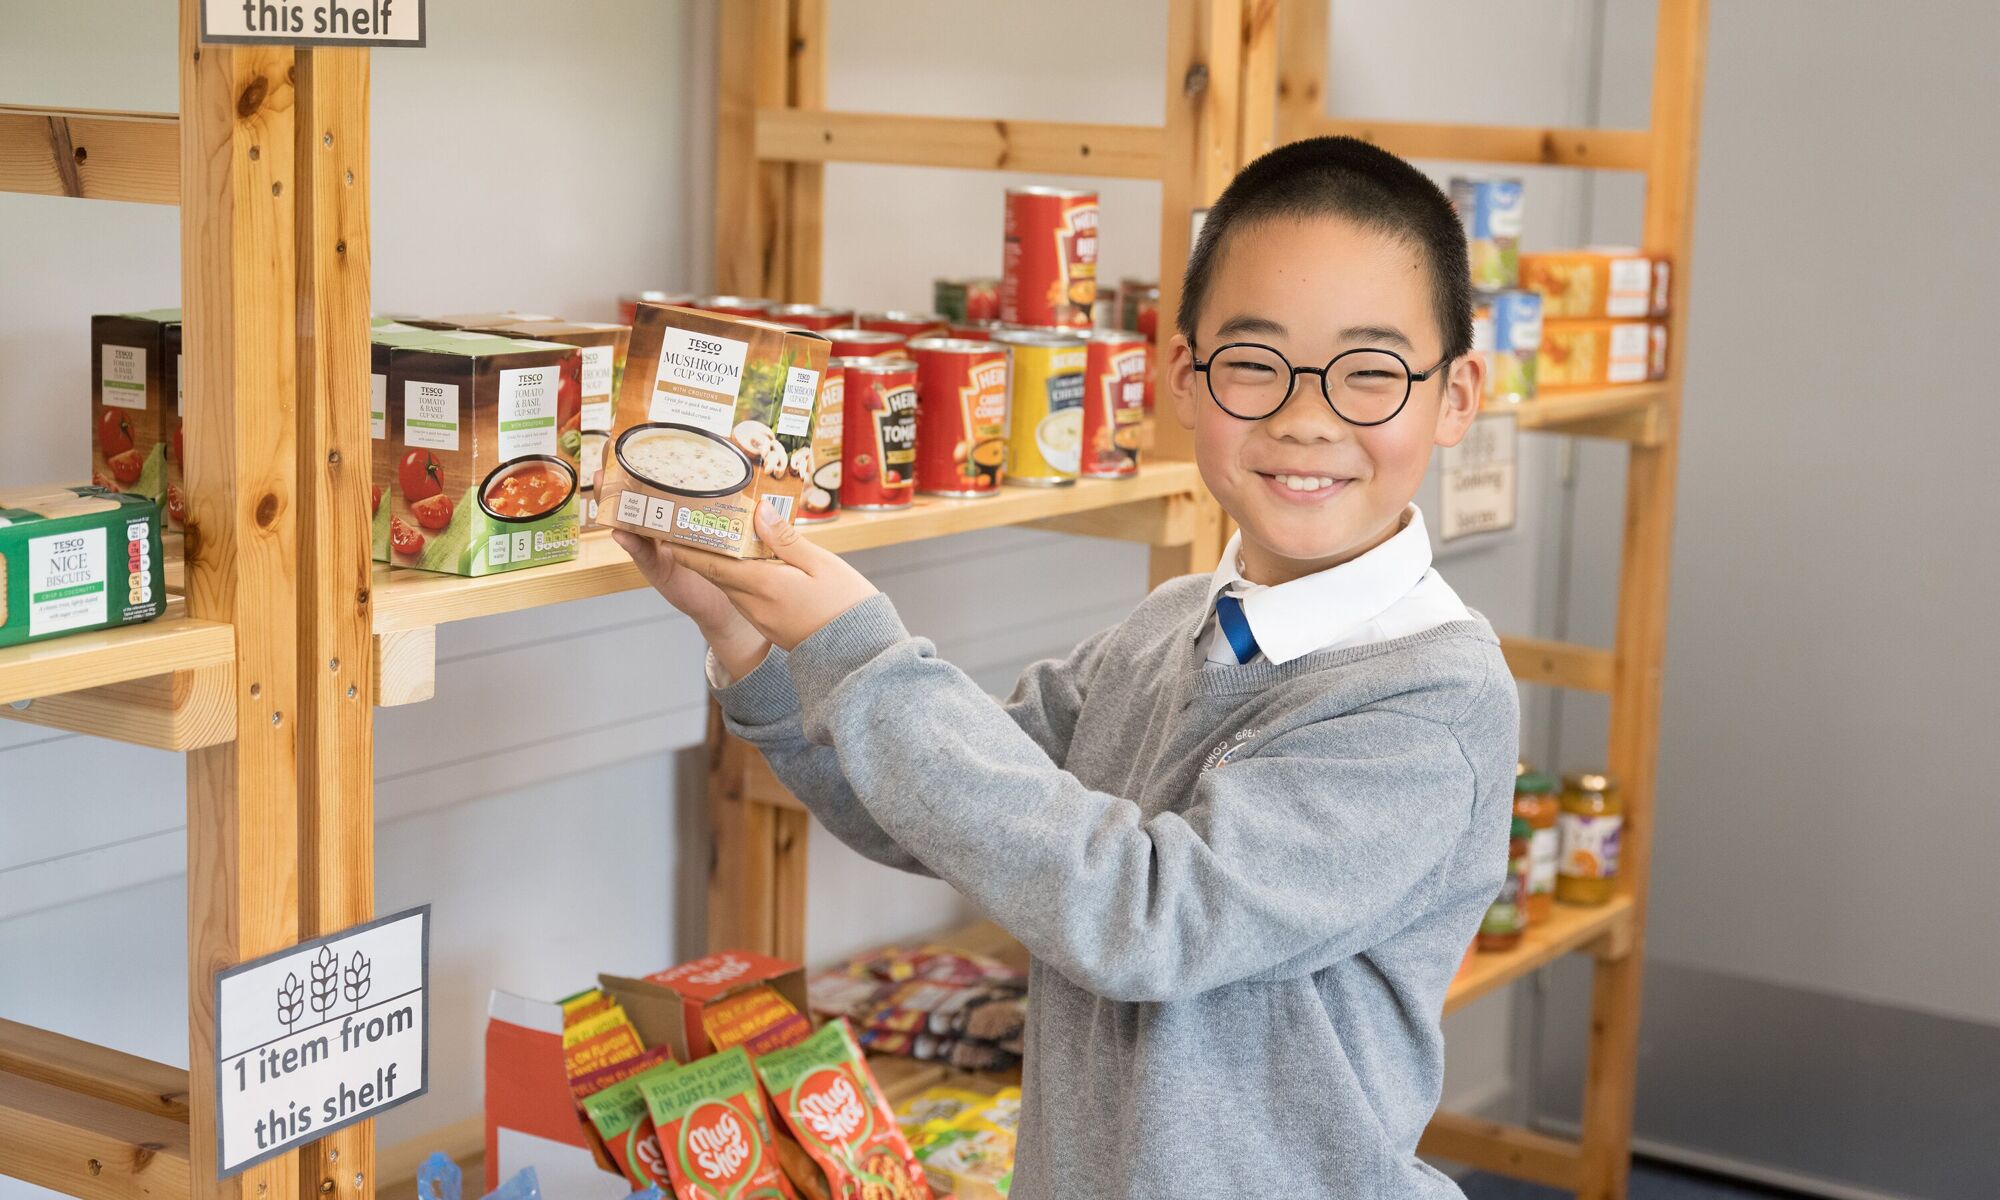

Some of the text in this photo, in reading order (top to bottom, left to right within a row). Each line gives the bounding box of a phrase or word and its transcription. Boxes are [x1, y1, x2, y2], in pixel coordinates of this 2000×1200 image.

[243, 0, 393, 35] this shelf
[688, 338, 722, 352] TESCO
[663, 351, 739, 378] MUSHROOM
[519, 374, 543, 382] TESCO
[673, 367, 725, 386] CUP SOUP
[421, 387, 443, 395] TESCO
[514, 388, 544, 398] TOMATO
[687, 389, 719, 400] CROUTONS
[419, 397, 445, 406] TOMATO
[521, 398, 541, 408] BASIL
[514, 407, 542, 417] CUP SOUP
[624, 504, 640, 513] boiling
[624, 511, 638, 519] water
[655, 507, 664, 520] 5
[54, 538, 84, 551] TESCO
[518, 539, 525, 551] 5
[50, 553, 88, 575] NICE
[46, 570, 92, 588] BISCUITS
[234, 1005, 413, 1092] 1 item from
[651, 1053, 743, 1097] FULL ON FLAVOUR
[658, 1067, 751, 1115] IN JUST 5 MINS
[800, 1076, 857, 1115] Mug
[254, 1062, 398, 1150] this shelf
[602, 1113, 620, 1130] IN
[812, 1101, 865, 1141] Shot
[689, 1111, 742, 1155] Mug
[697, 1139, 749, 1180] Shot
